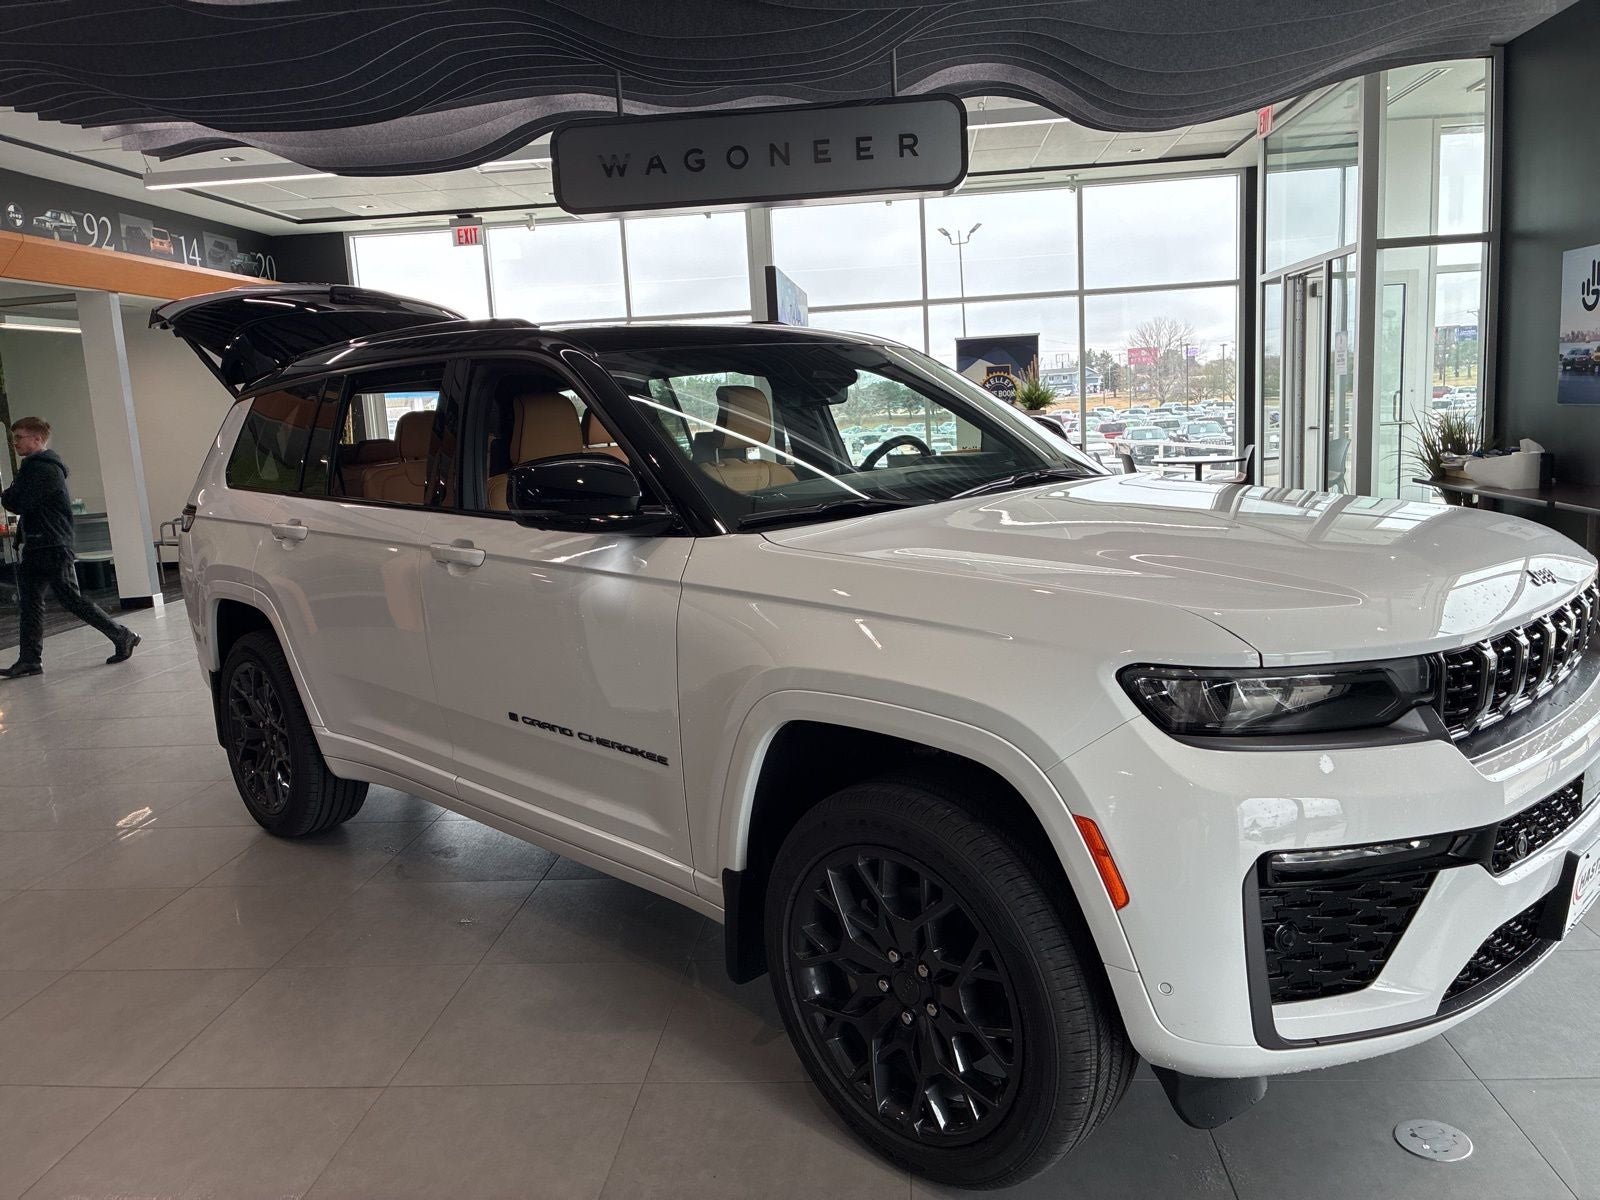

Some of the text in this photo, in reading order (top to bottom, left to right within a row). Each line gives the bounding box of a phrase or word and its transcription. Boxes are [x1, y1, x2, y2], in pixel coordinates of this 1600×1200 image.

[600, 132, 919, 178] WAGONEER
[83, 212, 115, 252] 92
[456, 227, 478, 245] EXIT
[178, 235, 201, 266] 14
[256, 252, 276, 281] 20
[985, 377, 1013, 388] KELLEY
[998, 388, 1016, 398] BOOK
[1526, 567, 1557, 587] Jeep
[521, 715, 669, 767] GRAND CHEROKEE
